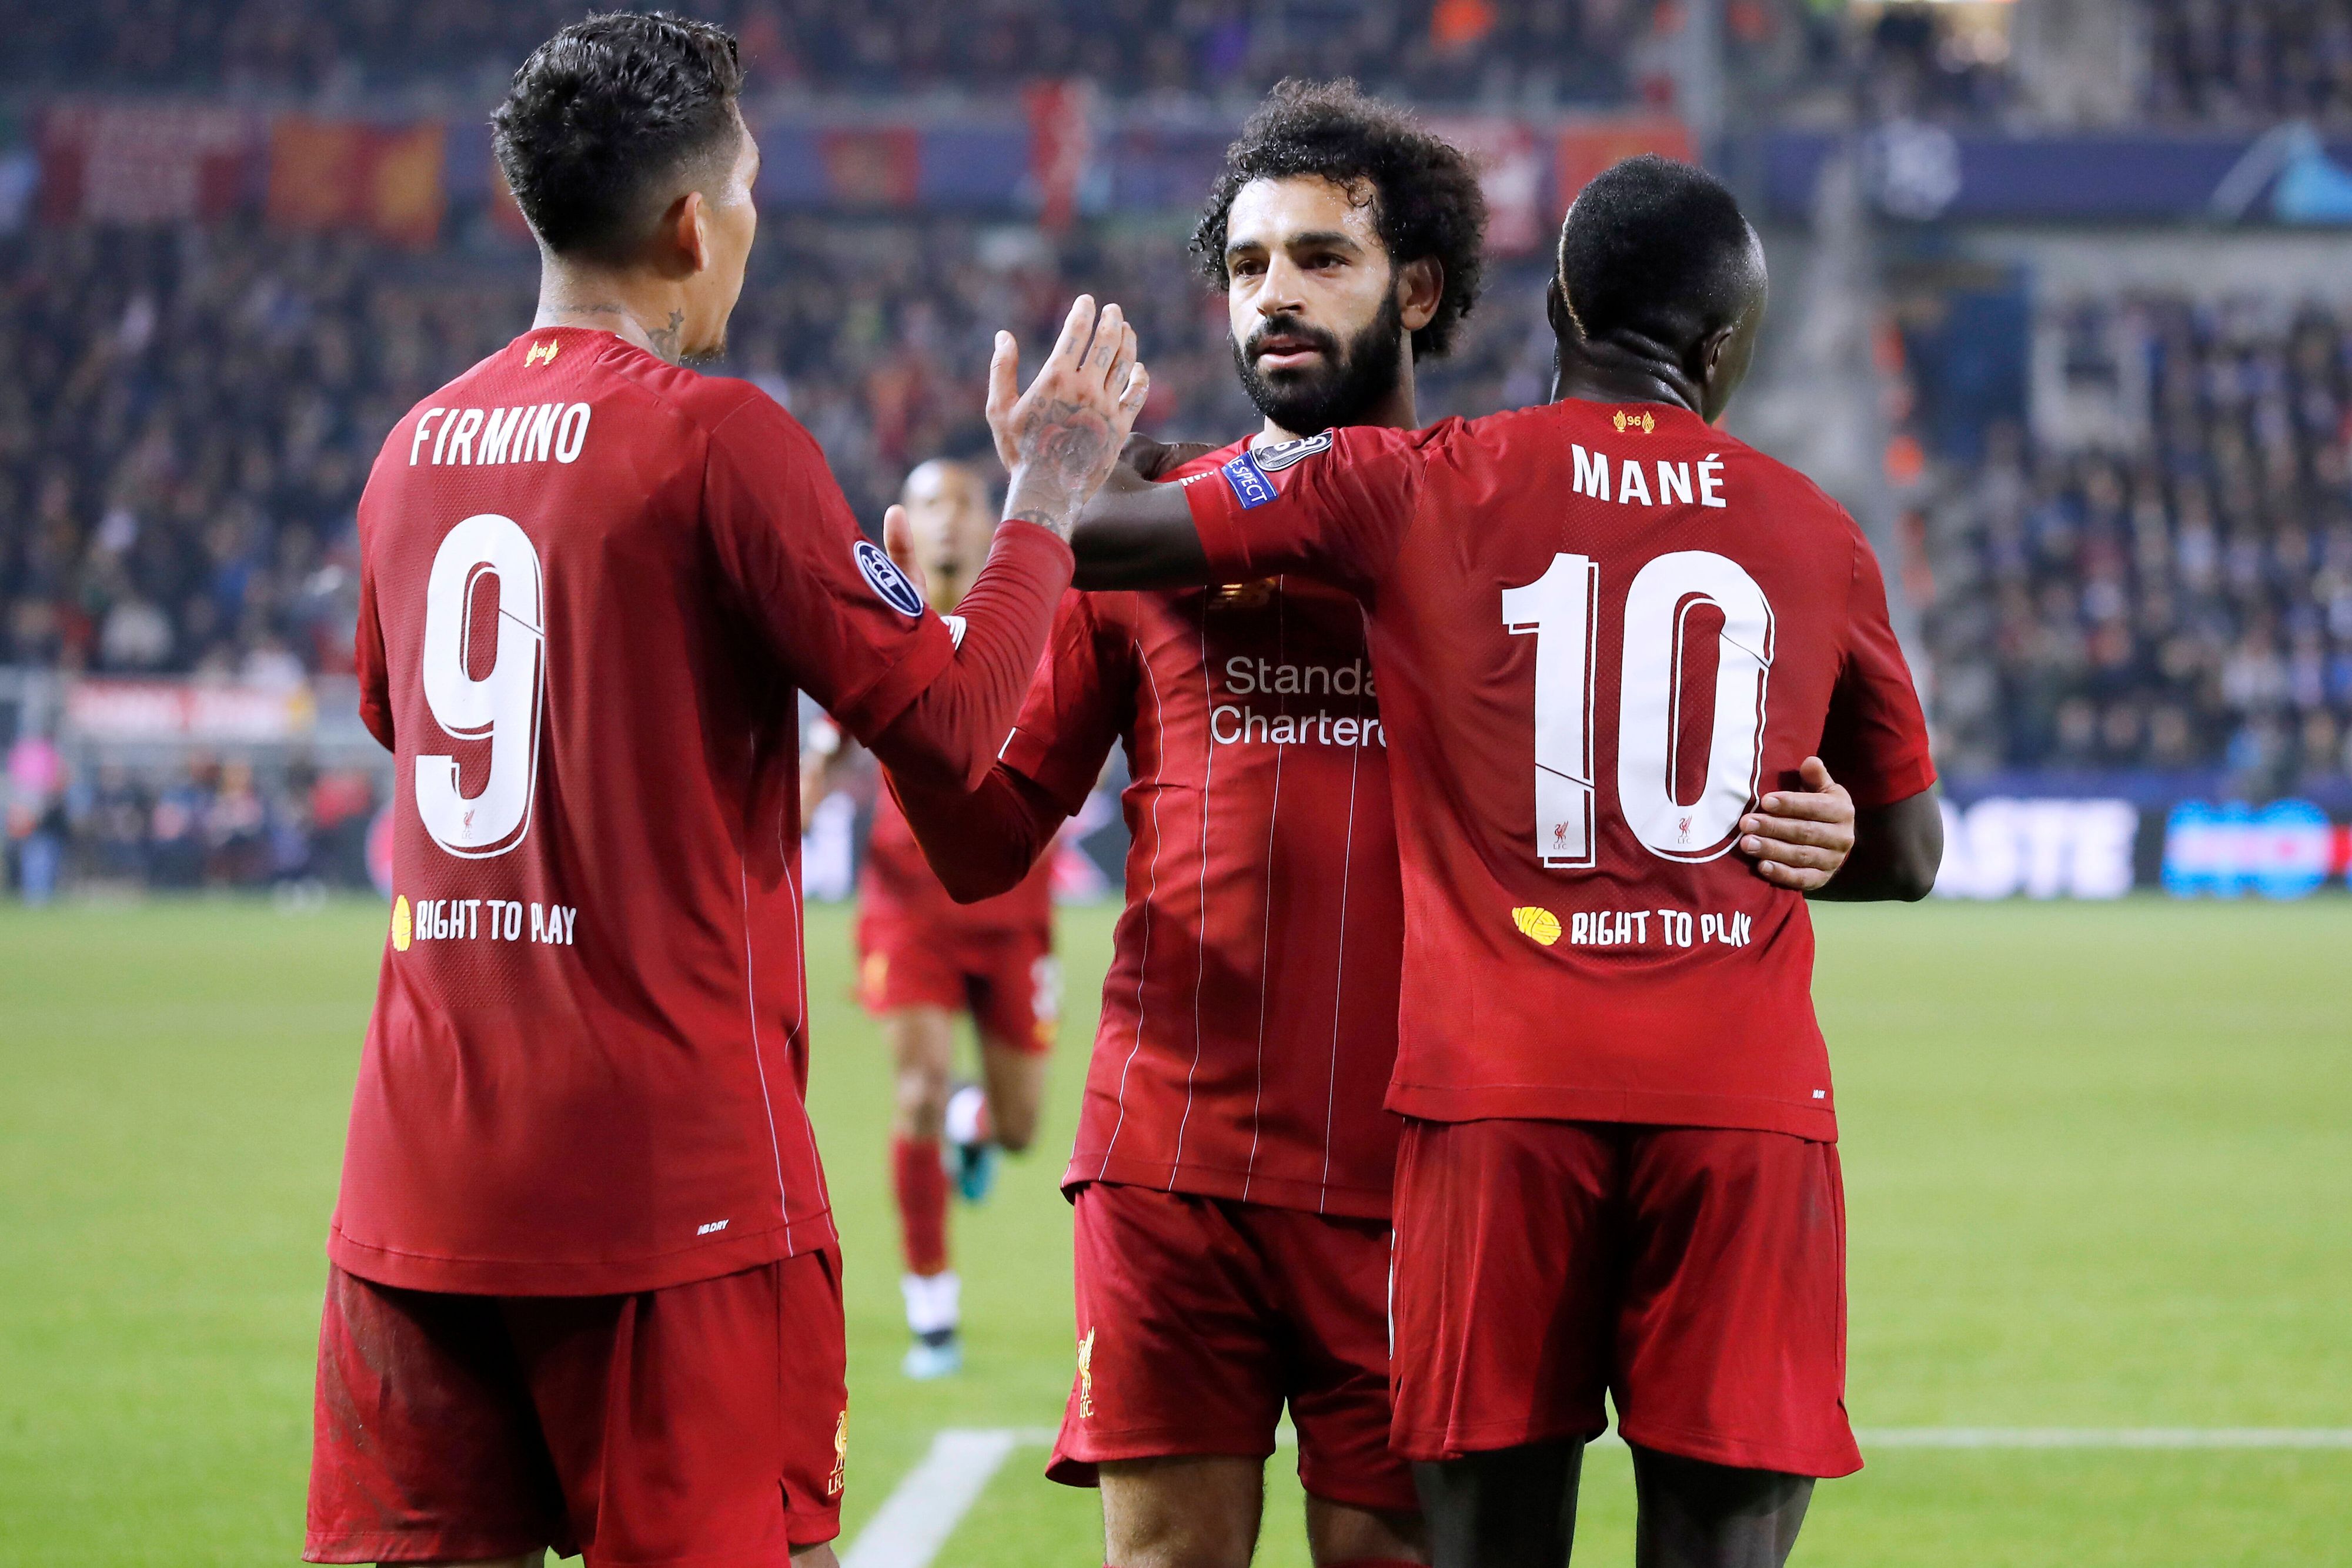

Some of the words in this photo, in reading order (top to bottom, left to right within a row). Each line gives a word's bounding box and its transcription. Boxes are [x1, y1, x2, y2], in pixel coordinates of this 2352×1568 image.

[536, 346, 549, 359] 96
[409, 402, 592, 466] FIRMINO
[1626, 415, 1642, 426] 96
[1227, 456, 1268, 502] ESPECT
[1571, 443, 1727, 508] MANÉ
[415, 513, 545, 860] 9
[1501, 550, 1775, 869] 10
[415, 899, 482, 941] RIGHT
[486, 899, 523, 941] TO
[530, 902, 577, 945] PLAY
[1571, 910, 1651, 945] RIGHT
[1657, 908, 1692, 948] TO
[1700, 910, 1752, 948] PLAY
[827, 1470, 844, 1496] LFC
